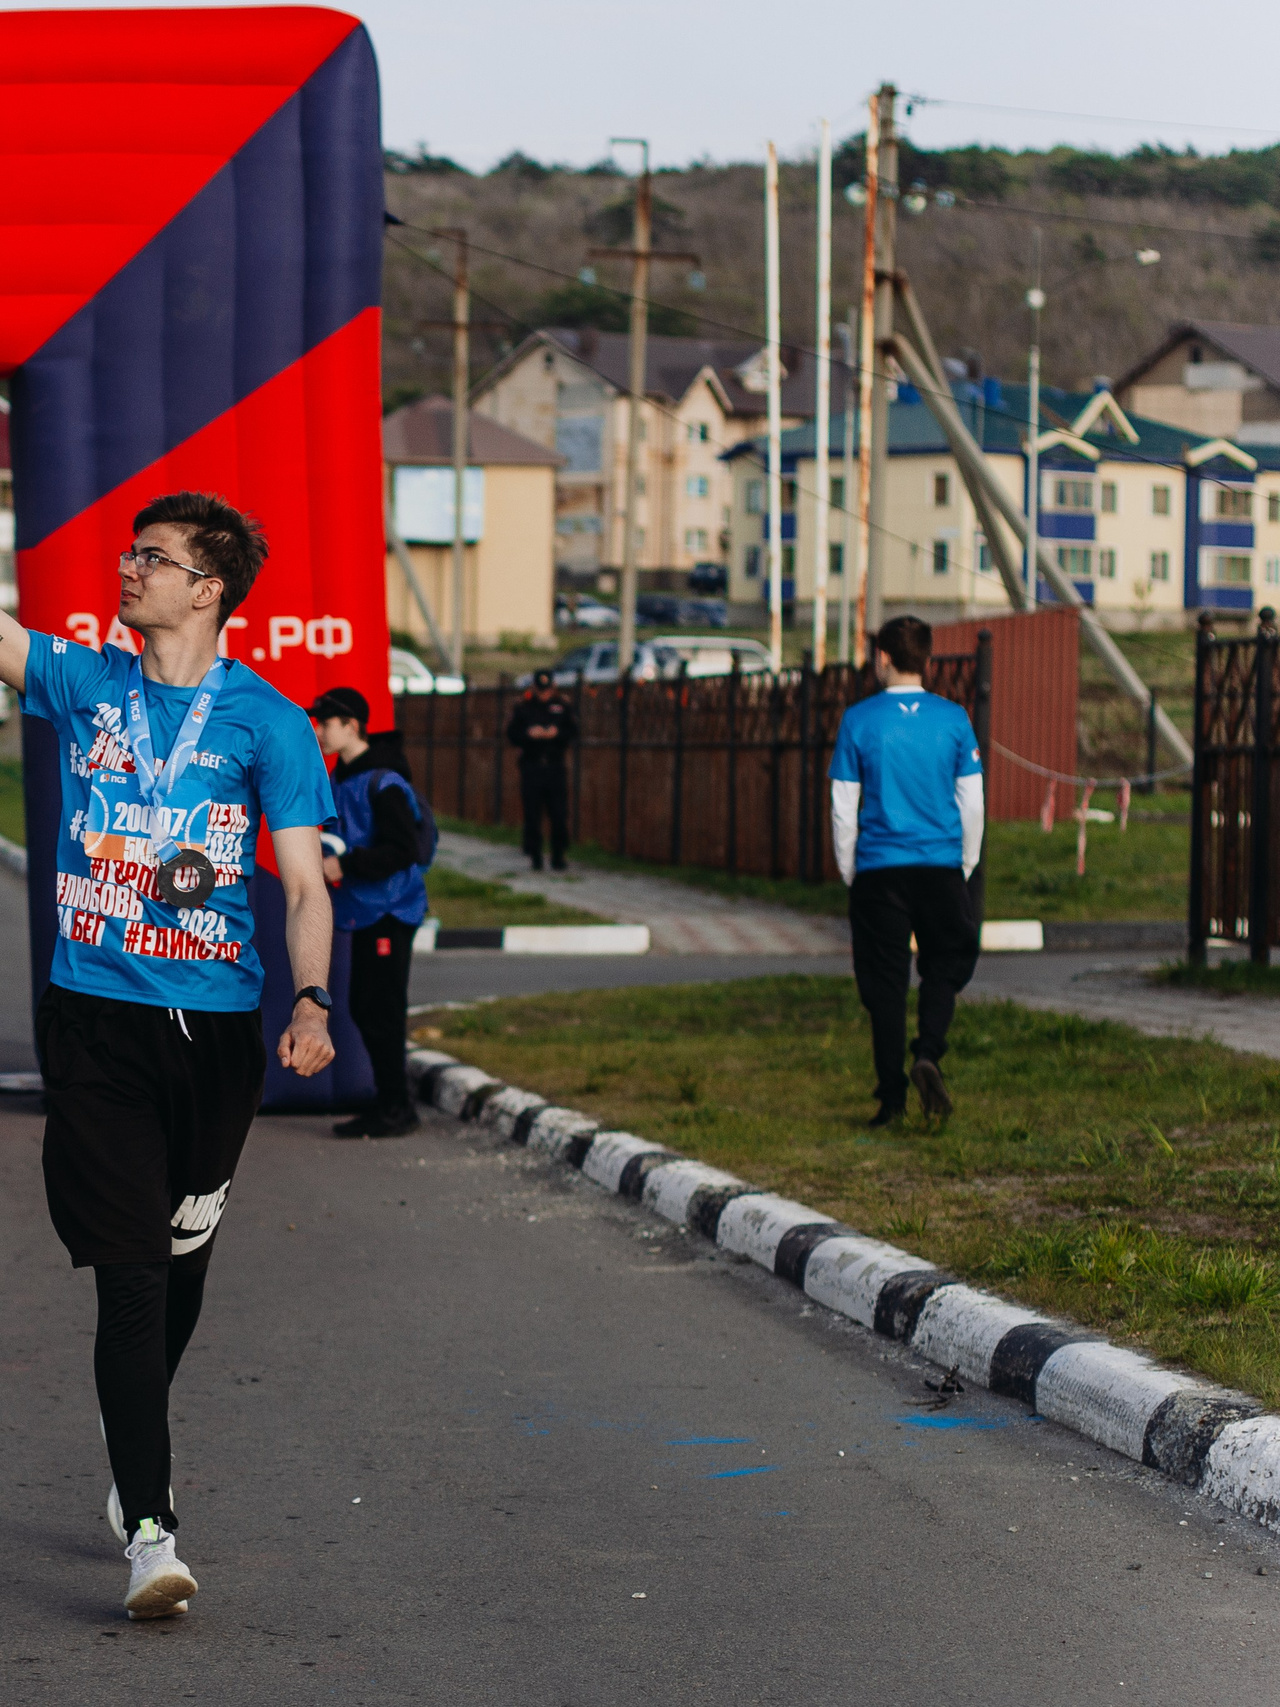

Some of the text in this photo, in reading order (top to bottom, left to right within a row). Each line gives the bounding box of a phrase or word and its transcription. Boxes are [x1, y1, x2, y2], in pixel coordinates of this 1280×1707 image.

[130, 700, 141, 721] ПСБ
[197, 692, 212, 711] ПСБ
[110, 775, 128, 784] ПСБ
[56, 872, 144, 921] #ЛЮБОВЬ
[170, 1178, 231, 1231] NIKE
